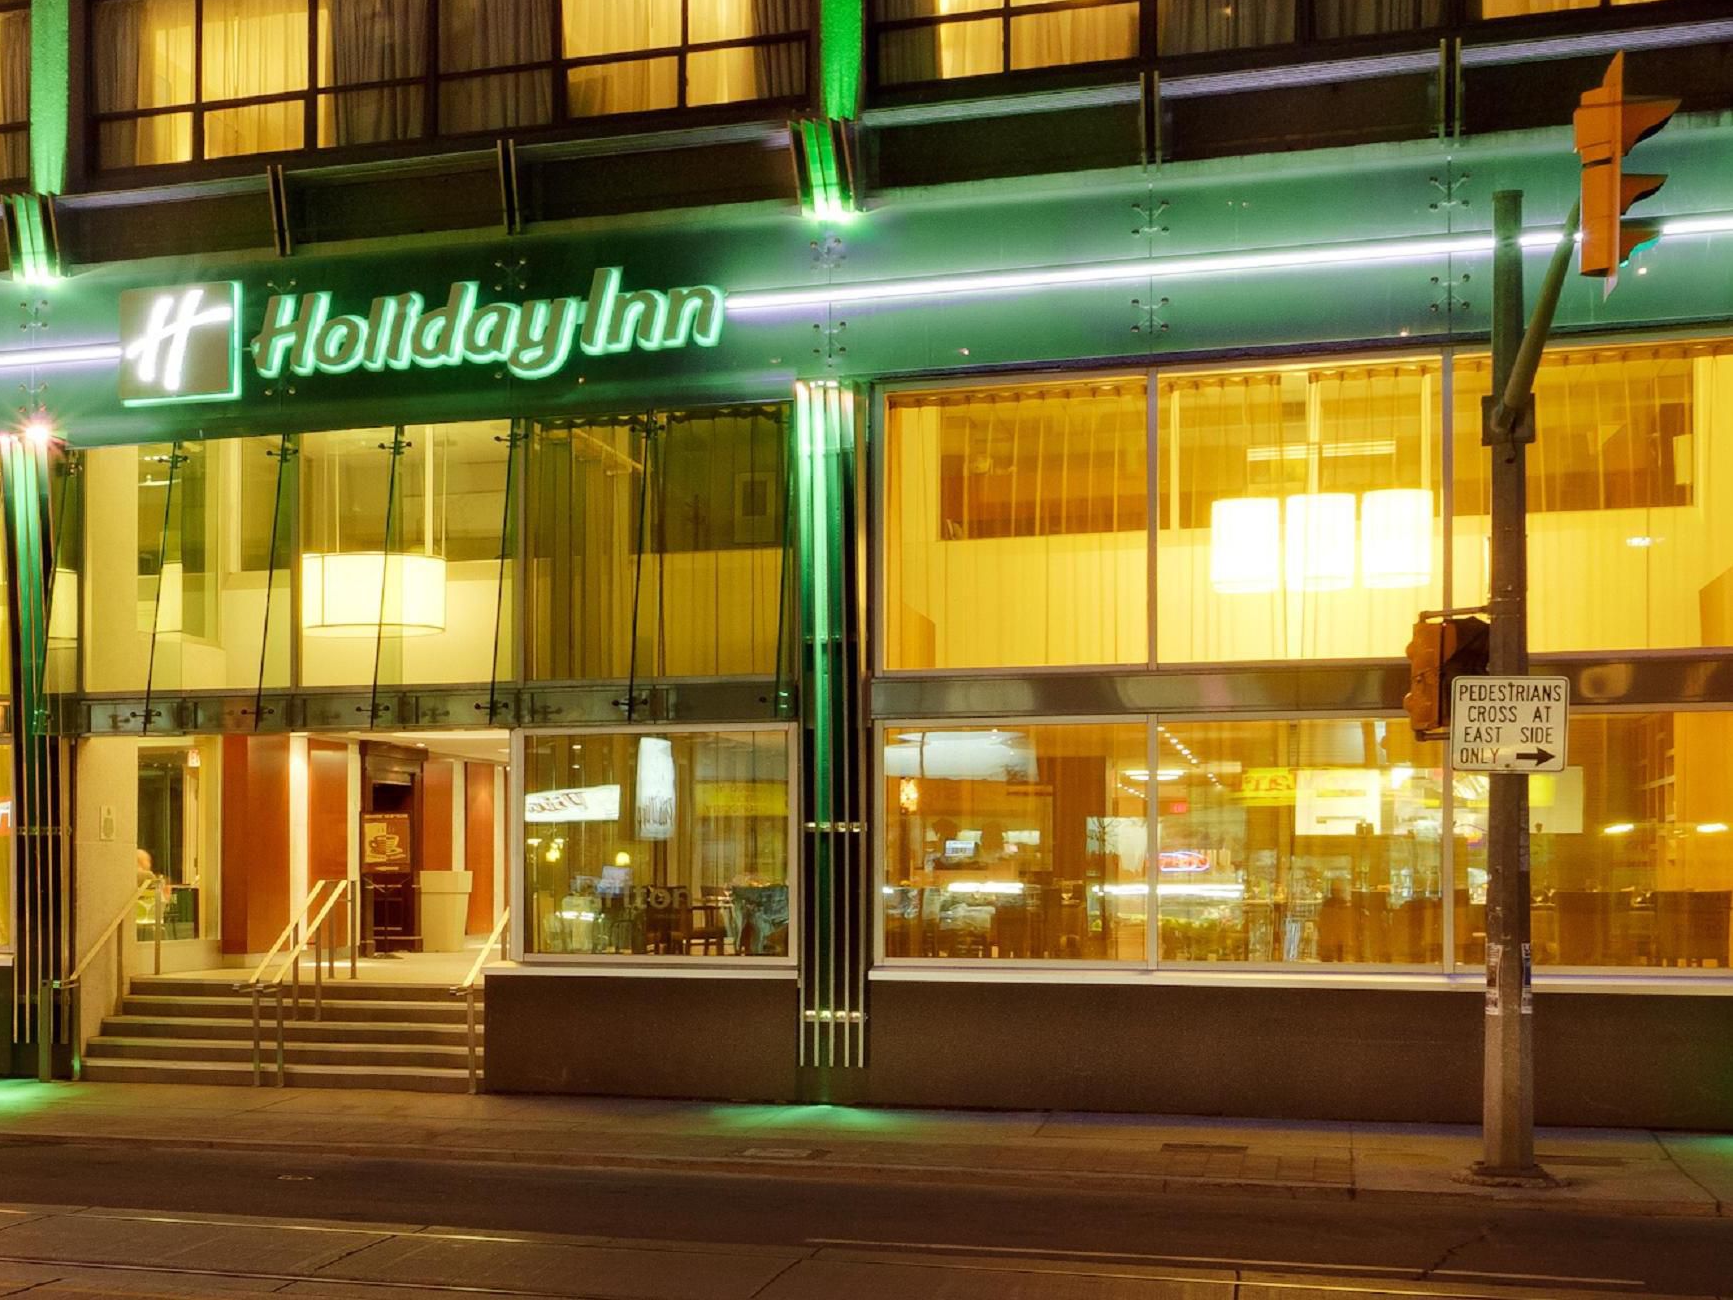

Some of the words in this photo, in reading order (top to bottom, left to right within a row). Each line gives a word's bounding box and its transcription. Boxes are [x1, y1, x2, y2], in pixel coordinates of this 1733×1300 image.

[251, 280, 578, 380] Holiday
[580, 266, 726, 356] Inn
[1459, 683, 1562, 703] PEDESTRIANS
[1468, 705, 1517, 723] CROSS
[1532, 705, 1551, 722] AT
[1464, 726, 1502, 744] EAST
[1520, 726, 1554, 744] SIDE
[1460, 747, 1500, 765] ONLY
